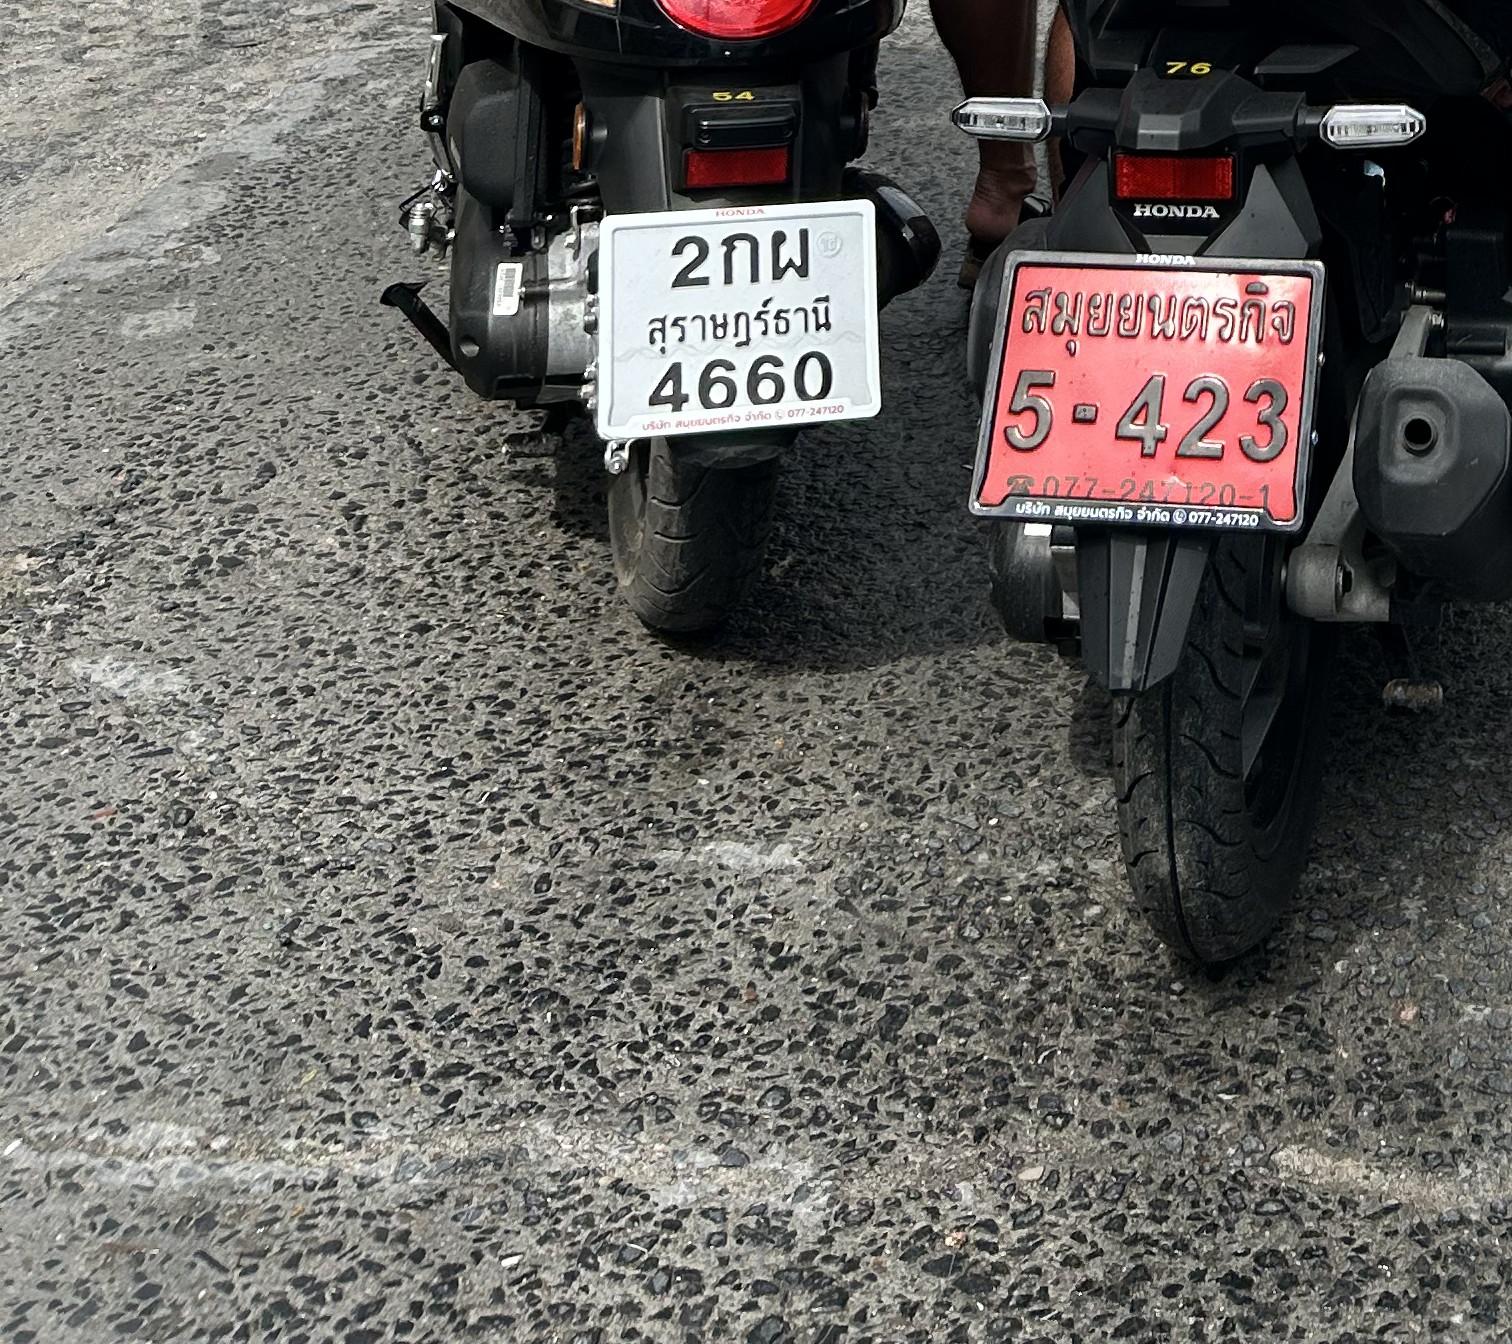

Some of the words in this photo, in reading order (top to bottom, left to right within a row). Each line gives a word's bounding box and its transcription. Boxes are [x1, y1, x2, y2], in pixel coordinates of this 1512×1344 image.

[1165, 60, 1213, 76] 76
[712, 90, 756, 102] 54
[715, 207, 766, 217] HONDA
[1133, 203, 1220, 219] HONDA
[671, 227, 811, 289] 2กผ
[1135, 253, 1196, 266] HONDA
[648, 295, 832, 355] สุราษฎร์ธานี
[1021, 281, 1296, 358] สมุยยนตรกิจ
[648, 350, 833, 413] 4660
[787, 404, 845, 419] 077-247120
[1016, 501, 1051, 516] บริษัท
[1137, 507, 1171, 523] จำกัด
[1189, 512, 1260, 528] 077-247120
